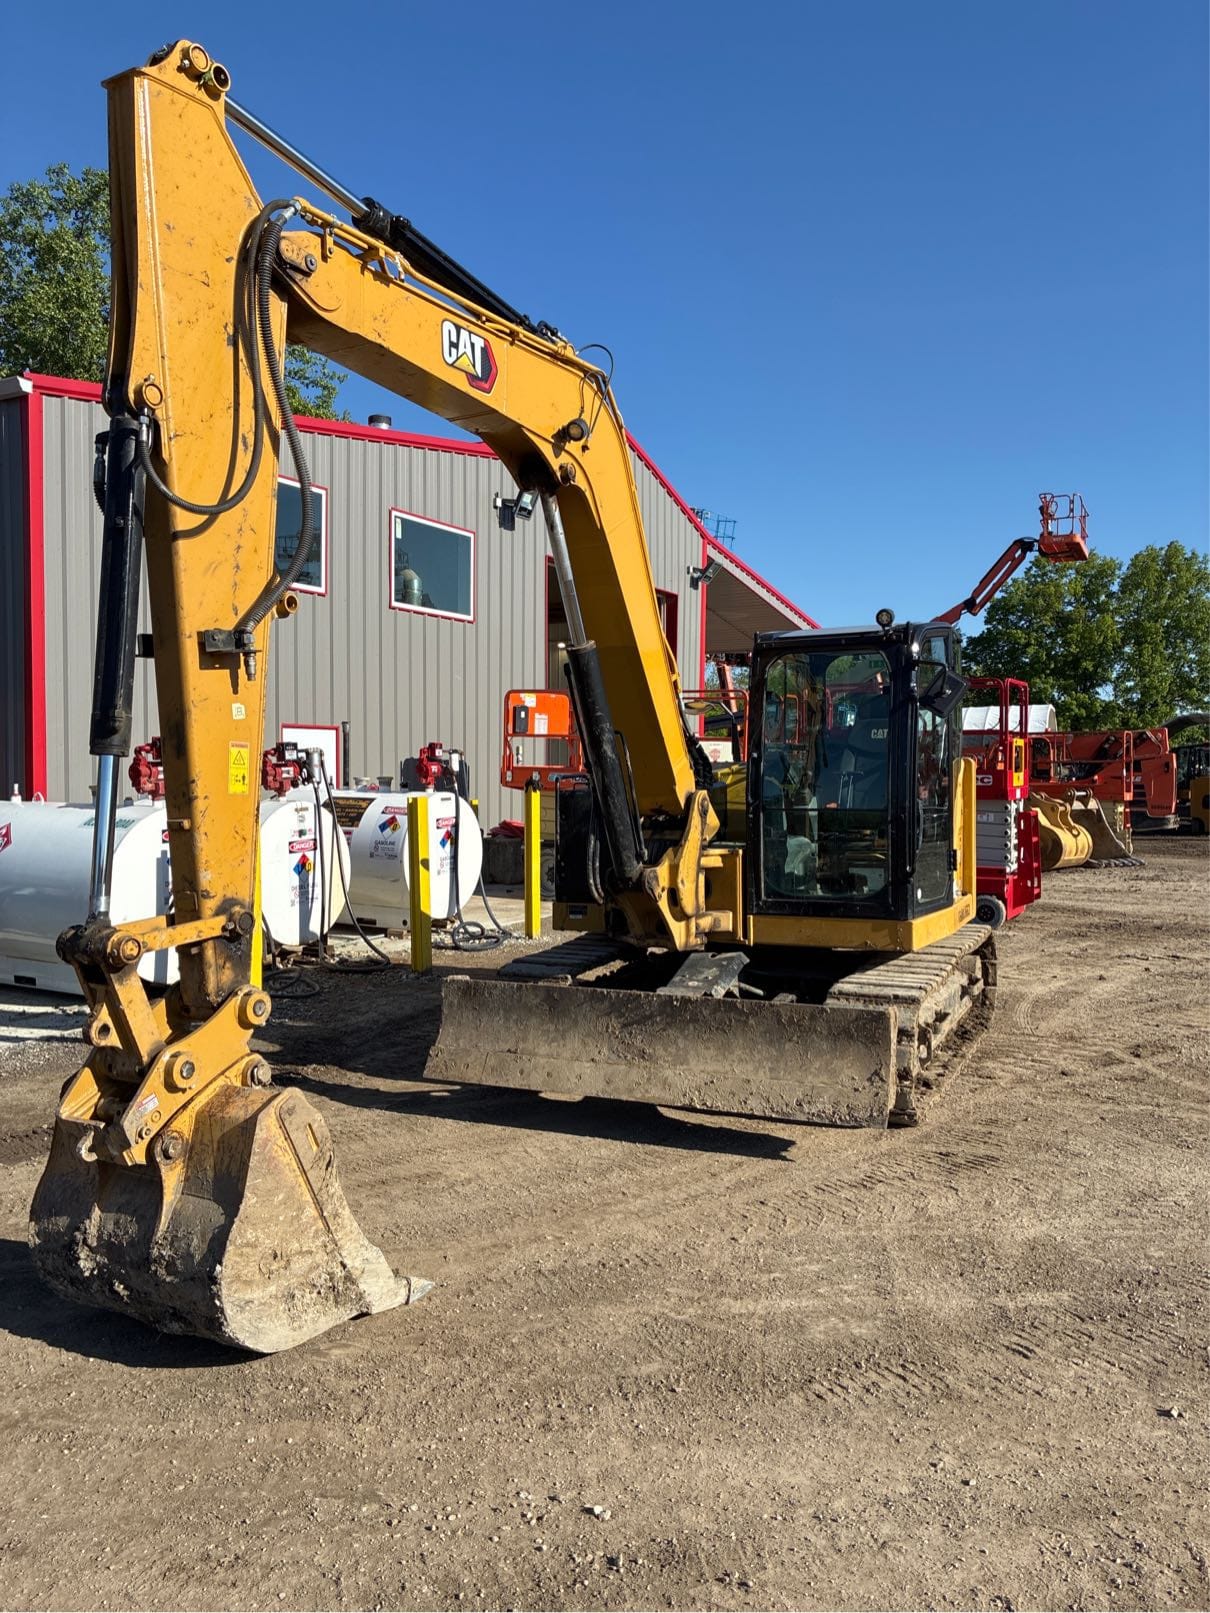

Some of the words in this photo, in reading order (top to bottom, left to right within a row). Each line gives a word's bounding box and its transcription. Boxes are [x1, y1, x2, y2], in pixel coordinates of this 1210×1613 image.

[442, 320, 485, 378] CAT
[871, 728, 888, 738] CAT
[291, 840, 314, 851] DANGER
